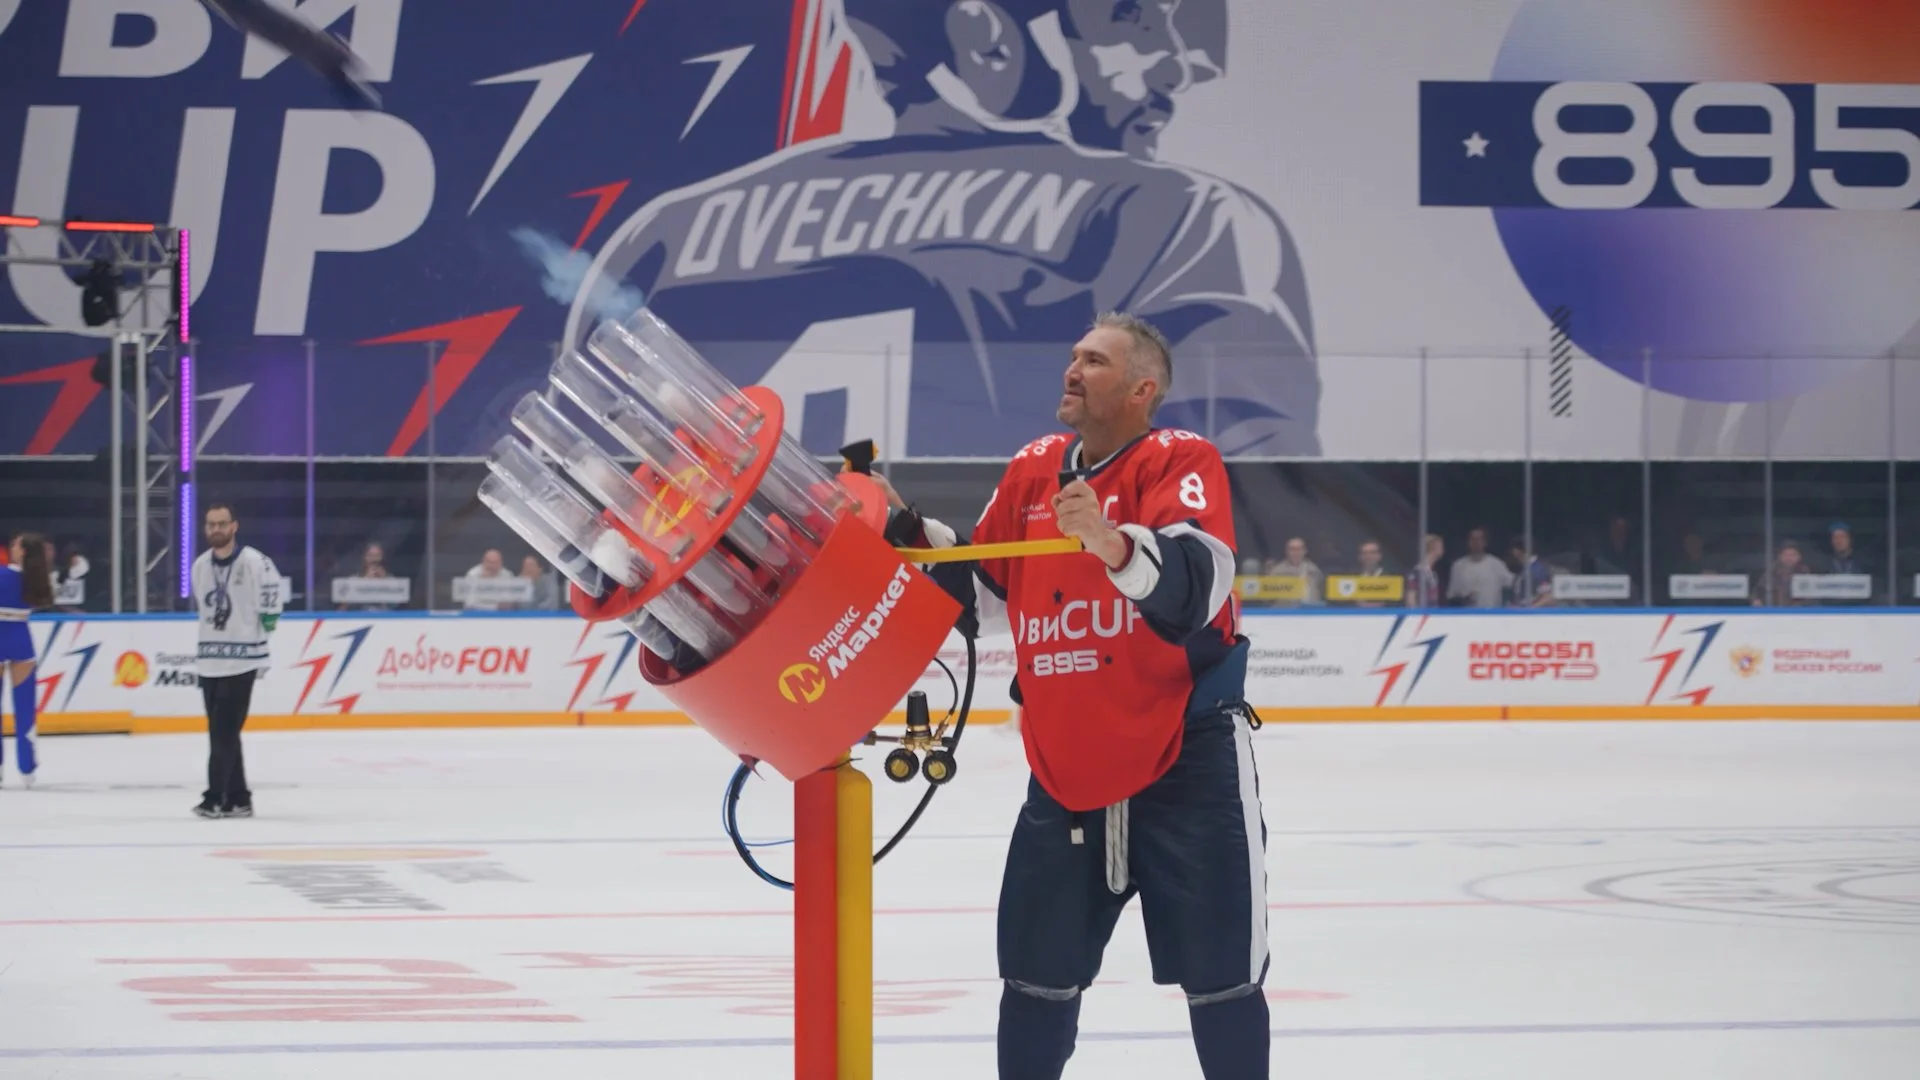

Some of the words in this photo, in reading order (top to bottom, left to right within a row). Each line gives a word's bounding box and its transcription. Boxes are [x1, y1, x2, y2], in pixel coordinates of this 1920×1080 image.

[1532, 81, 1920, 210] 895
[673, 168, 1096, 278] OVECHKIN
[1178, 471, 1207, 510] 8
[808, 604, 861, 662] Яндекс
[826, 562, 912, 679] Маркет
[1034, 649, 1099, 677] 895
[1468, 642, 1594, 659] МОСОБЛ
[1469, 663, 1567, 680] СПОРТ
